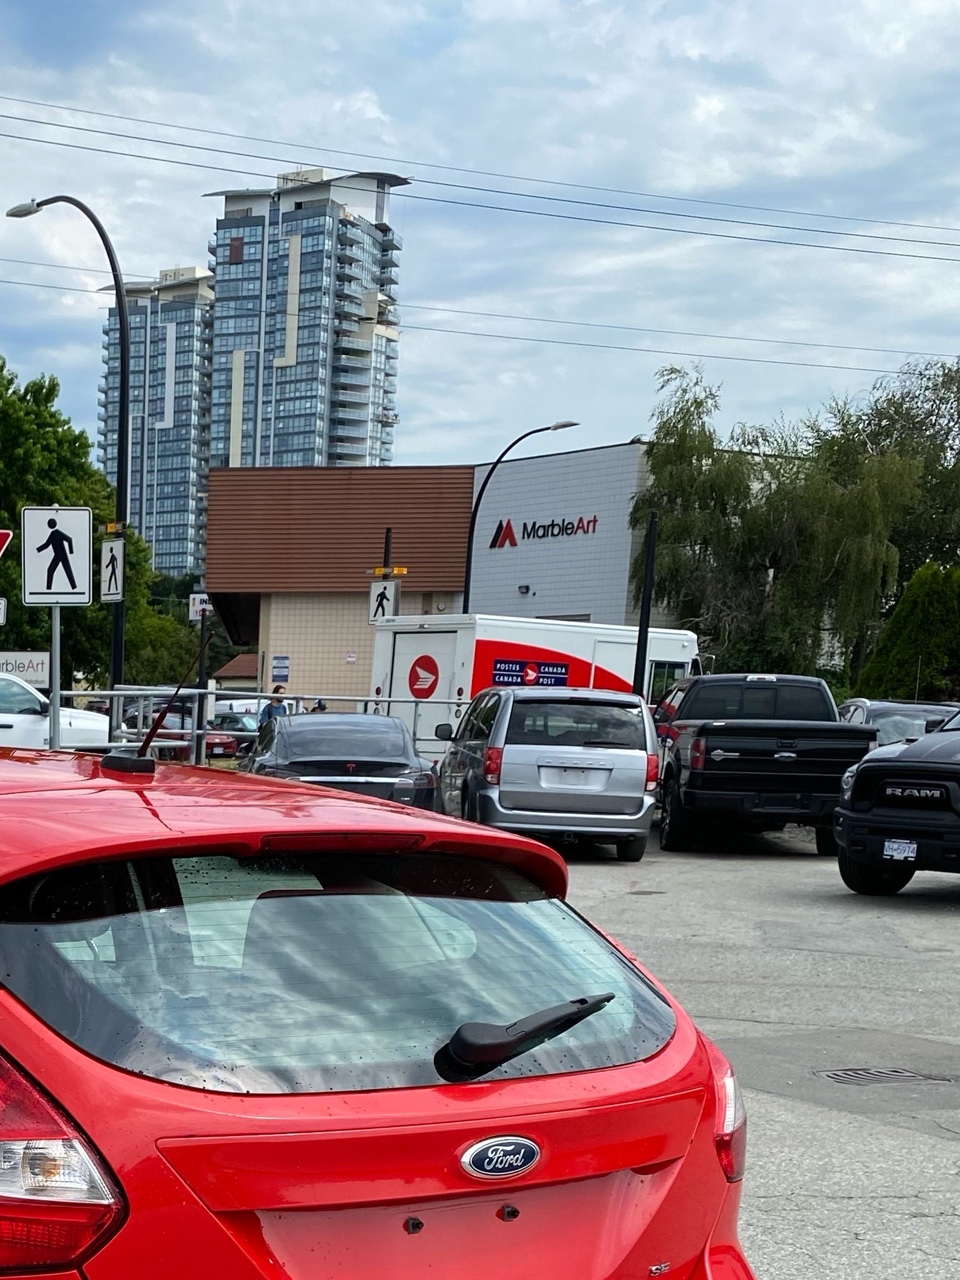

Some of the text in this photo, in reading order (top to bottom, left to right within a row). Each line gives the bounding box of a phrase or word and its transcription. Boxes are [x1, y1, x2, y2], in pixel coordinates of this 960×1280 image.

[522, 515, 598, 540] MarbleArt
[496, 663, 520, 671] POSTES
[540, 665, 566, 674] CANADA
[495, 675, 522, 683] CANADA
[539, 677, 555, 685] POST
[886, 788, 941, 797] RAM
[483, 1144, 525, 1171] Ford
[649, 1262, 671, 1277] SE
